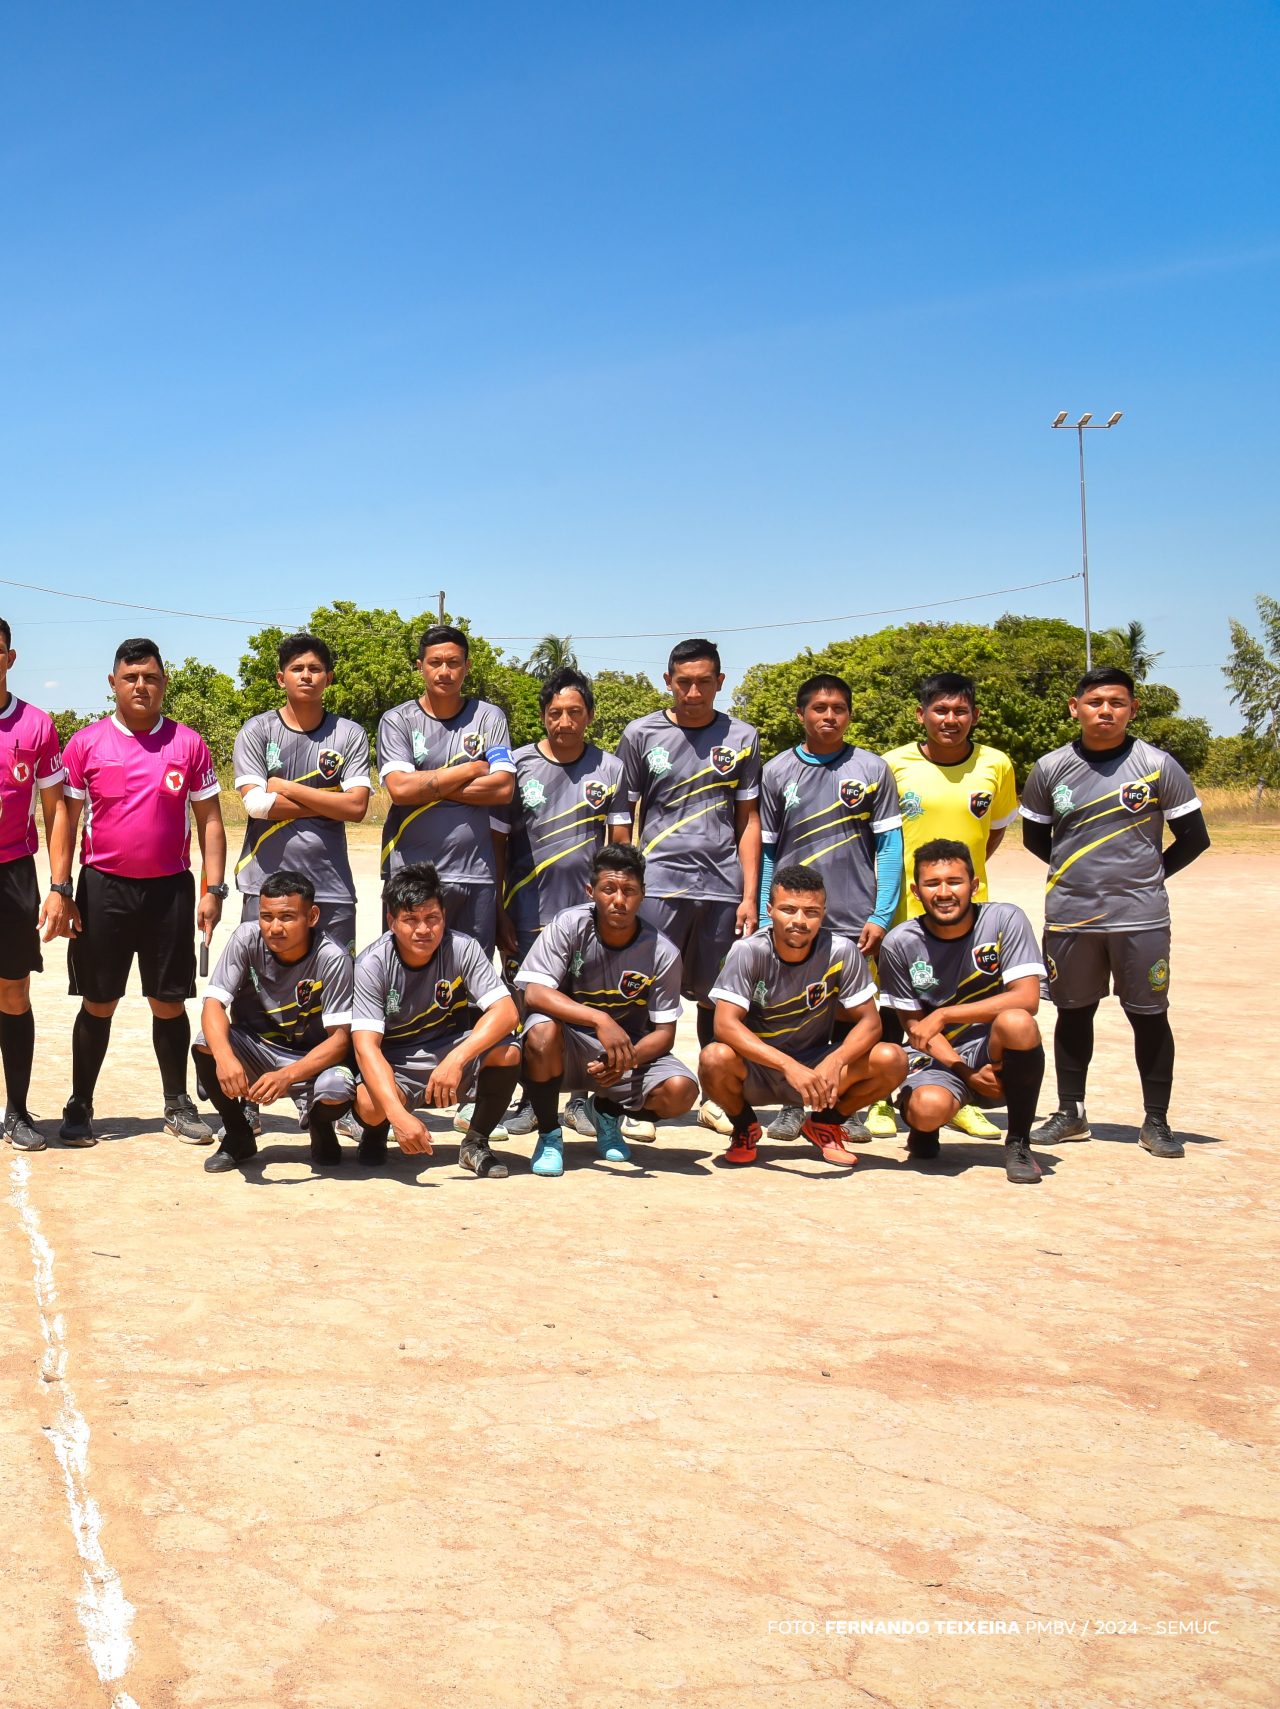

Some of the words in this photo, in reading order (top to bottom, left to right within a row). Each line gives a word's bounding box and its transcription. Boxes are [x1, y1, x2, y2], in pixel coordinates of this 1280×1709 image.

[718, 755, 731, 763] IFC
[324, 759, 335, 768] IFC
[591, 790, 602, 798] IFC
[846, 788, 859, 797] IFC
[1128, 792, 1143, 800] IFC
[976, 800, 989, 808] IFC
[982, 953, 997, 963] IFC
[627, 981, 640, 989] IFC
